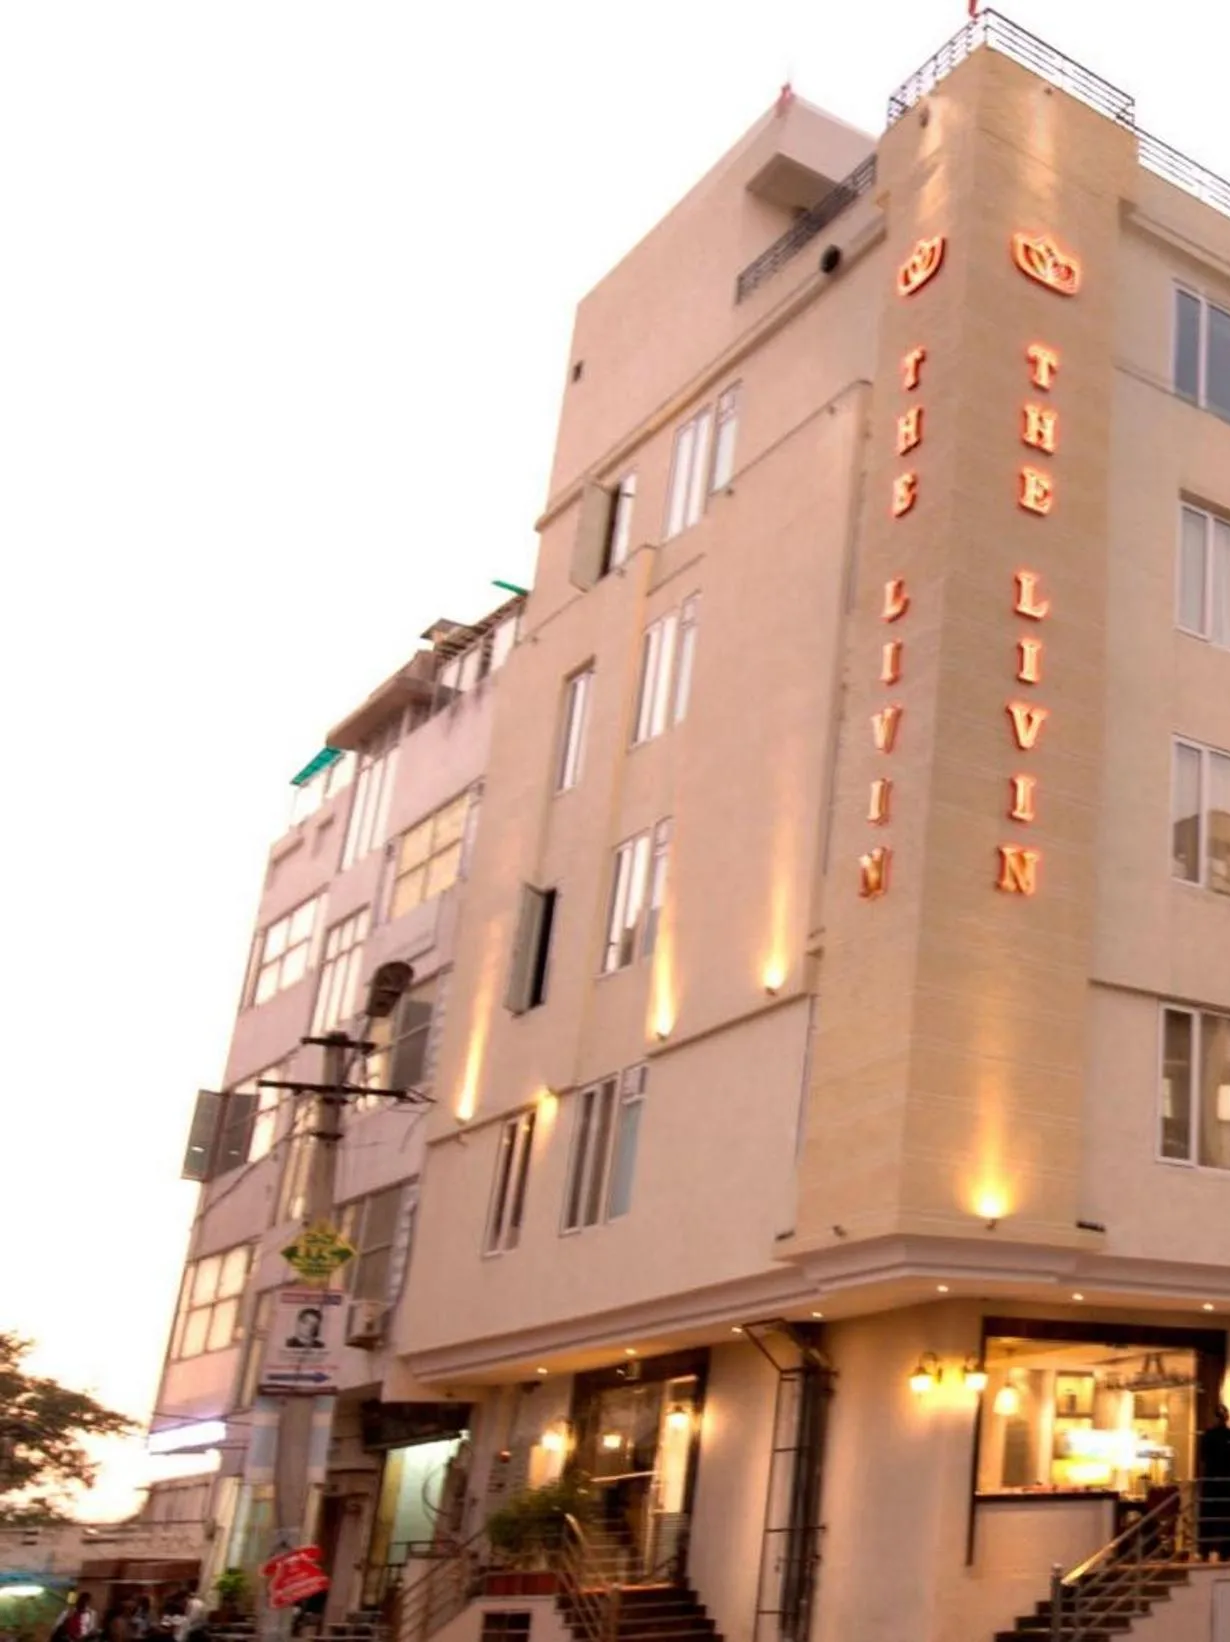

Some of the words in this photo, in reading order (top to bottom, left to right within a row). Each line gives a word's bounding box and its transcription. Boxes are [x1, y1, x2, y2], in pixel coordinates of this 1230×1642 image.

[891, 346, 927, 519] THE
[1018, 343, 1060, 518] THE
[858, 576, 911, 900] LIVIN
[996, 569, 1051, 898] LIVIN
